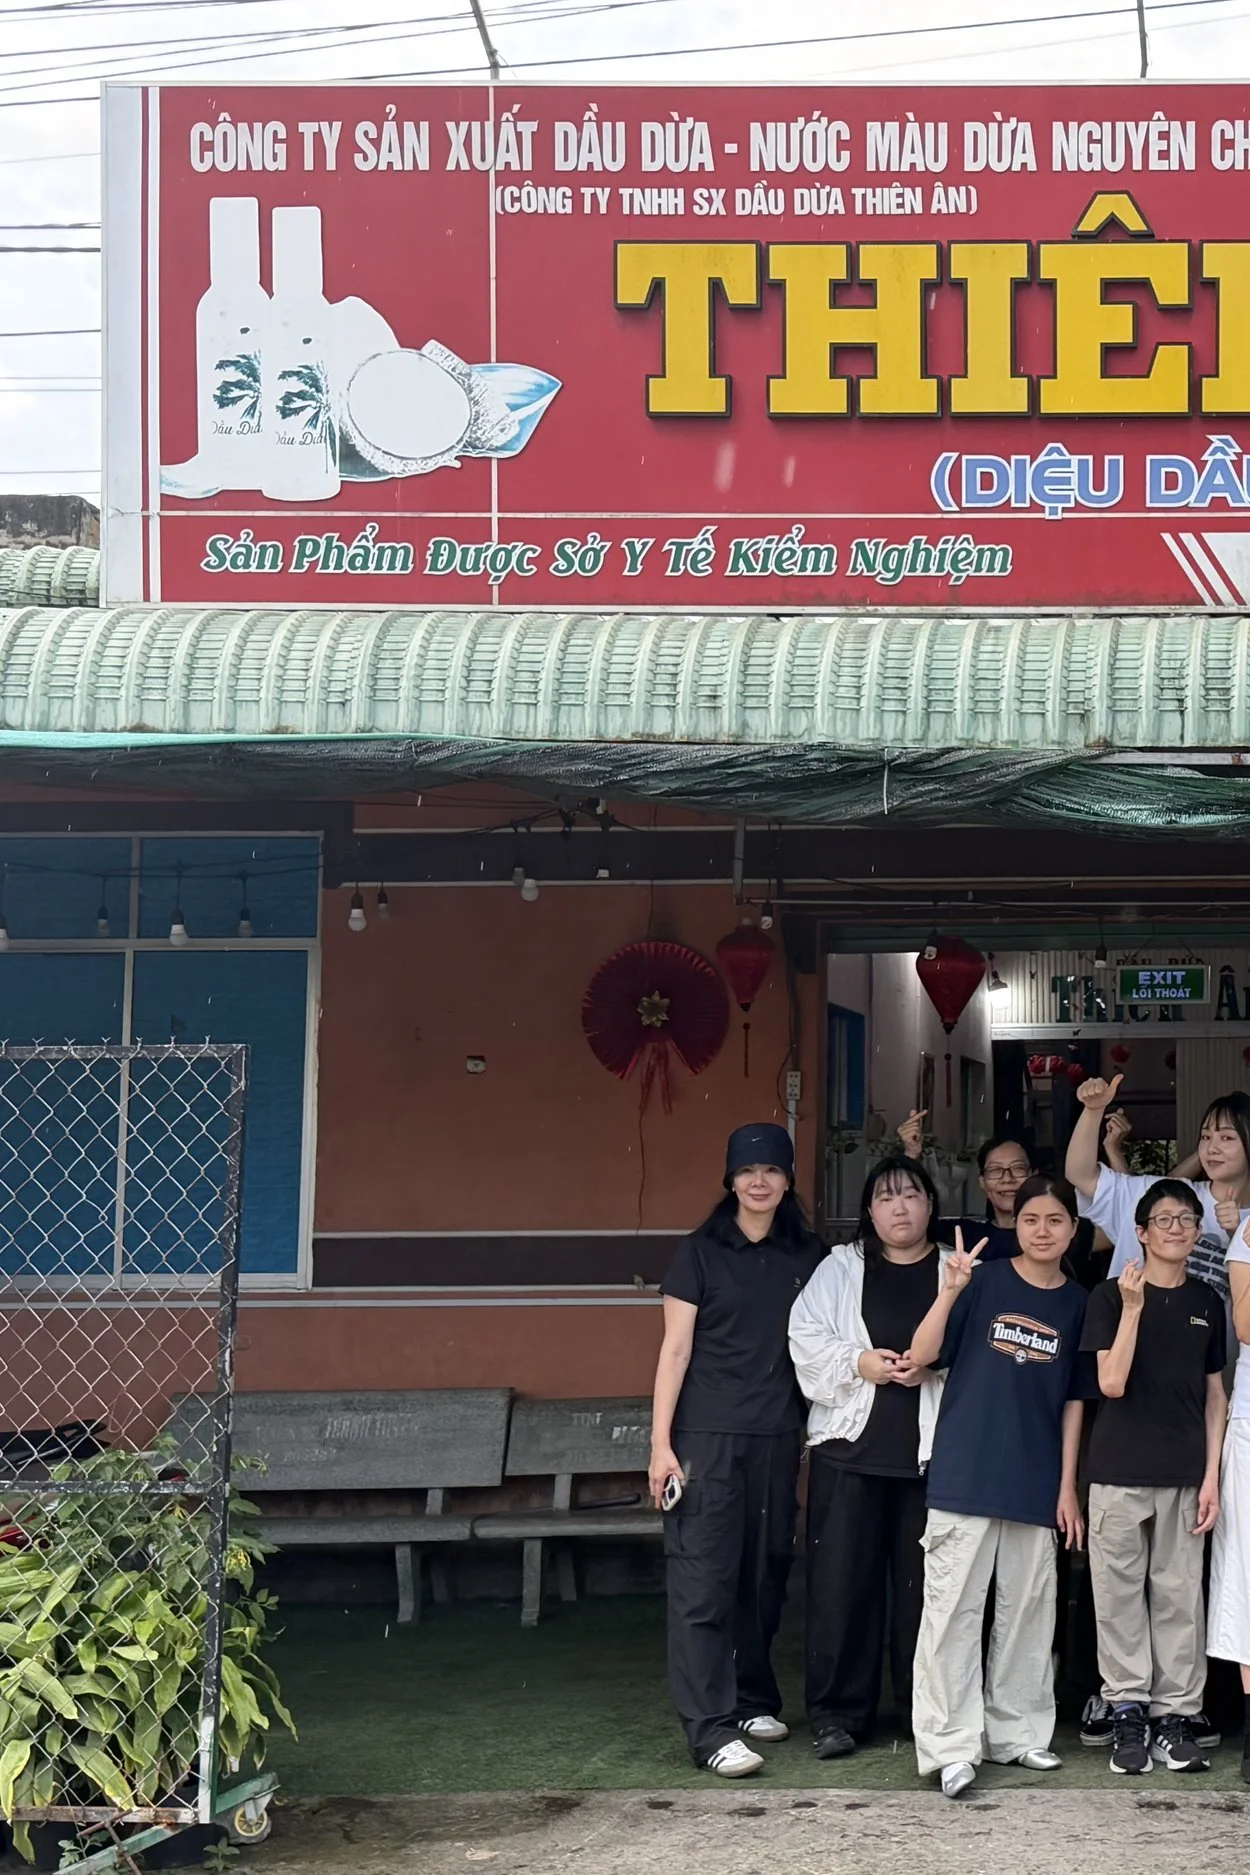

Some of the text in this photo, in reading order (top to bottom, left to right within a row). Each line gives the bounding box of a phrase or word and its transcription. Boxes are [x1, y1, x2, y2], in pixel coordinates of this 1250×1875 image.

[189, 112, 287, 174] CÔNG
[298, 119, 343, 173] TY
[353, 104, 430, 173] SẢN
[445, 103, 539, 174] XUẤT
[554, 103, 626, 173] DẦU
[641, 112, 714, 173] DỪA
[750, 111, 850, 173] NƯỚC
[866, 112, 949, 173] MÀU
[964, 112, 1037, 173] DỪA
[1052, 111, 1197, 173] NGUYÊN
[494, 180, 978, 216] (CÔNG TY TNHH SX DẦU DỪA THIÊN ÂN)
[930, 442, 1124, 519] (DIỆU
[200, 522, 1014, 585] Sản Phẩm Được Sở Y Tế Kiểm Nghiệm
[1138, 971, 1186, 985] EXIT
[993, 1322, 1059, 1354] Timberland
